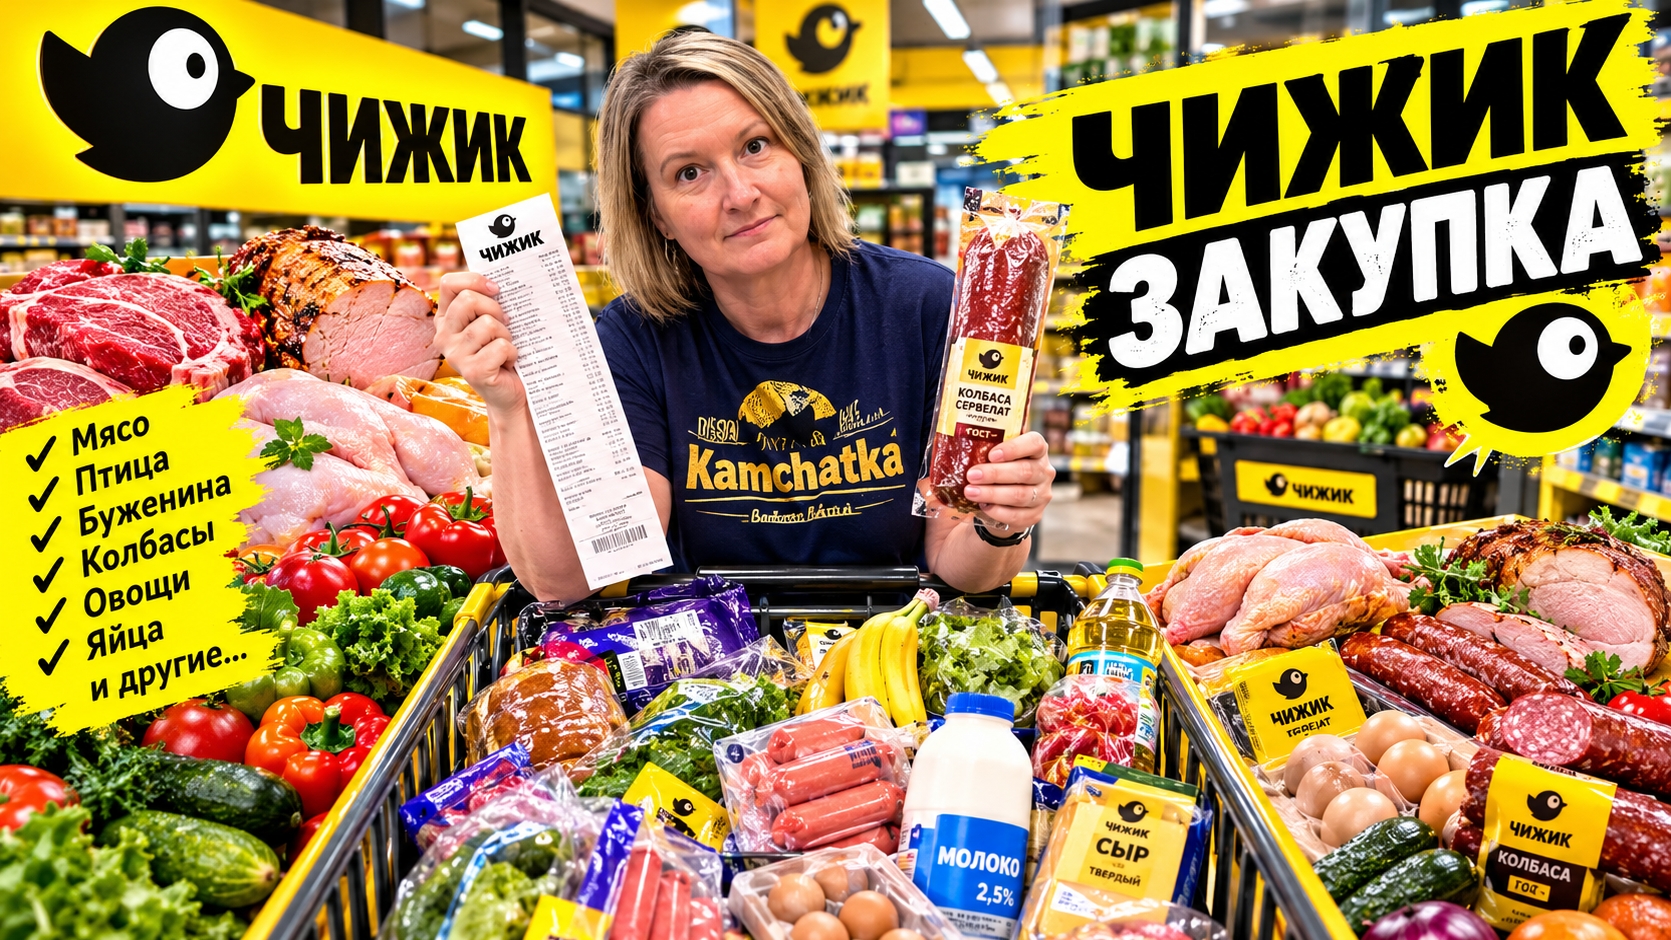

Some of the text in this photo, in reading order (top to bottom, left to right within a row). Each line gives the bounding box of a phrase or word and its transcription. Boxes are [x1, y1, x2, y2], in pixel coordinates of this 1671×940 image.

[261, 83, 533, 185] ЧИЖИК
[479, 229, 545, 263] ЧИЖИК
[967, 369, 1010, 384] ЧИЖИК
[955, 400, 1012, 416] СЕРВЕЛАТ
[958, 387, 1012, 406] КОЛБАСА
[1292, 483, 1354, 504] ЧИЖИК
[1270, 695, 1334, 726] ЧИЖИК
[1105, 821, 1151, 839] ЧИЖИК
[1510, 820, 1573, 848] ЧИЖИК
[937, 845, 1020, 878] МОЛОКО
[1096, 837, 1150, 863] СЫР
[1089, 866, 1142, 887] ТВЕРДЫЙ
[1498, 849, 1571, 882] КОЛБАСА
[976, 882, 1015, 907] 2,5%
